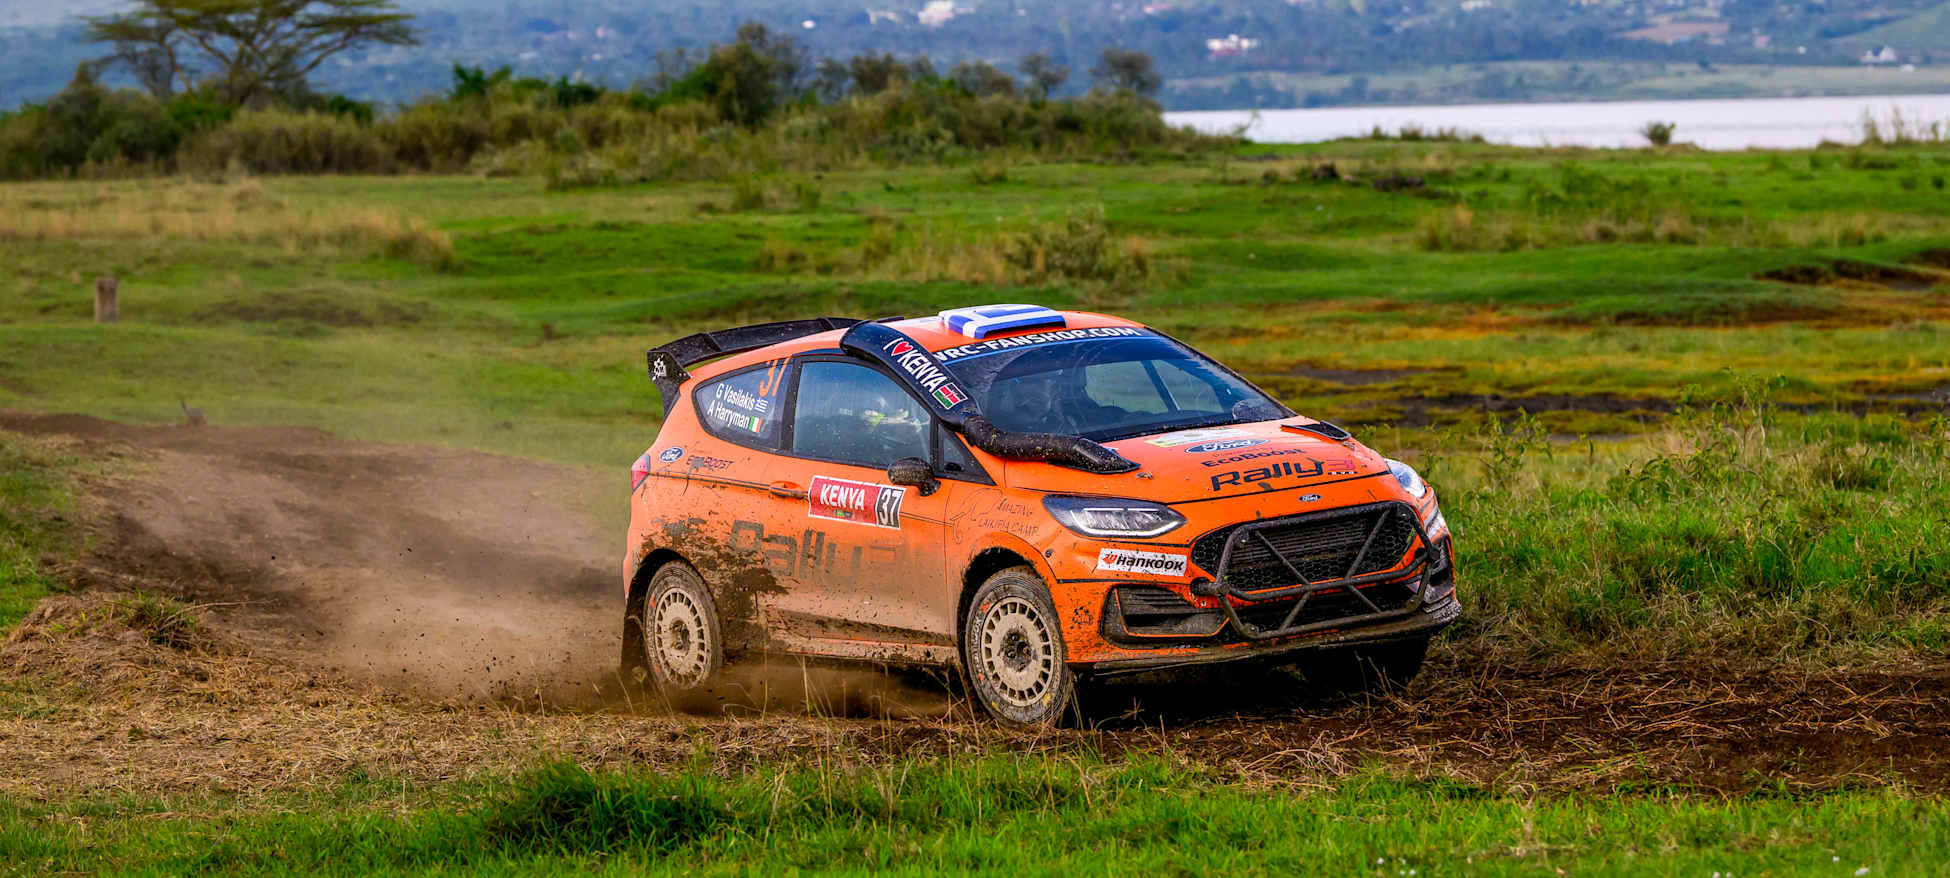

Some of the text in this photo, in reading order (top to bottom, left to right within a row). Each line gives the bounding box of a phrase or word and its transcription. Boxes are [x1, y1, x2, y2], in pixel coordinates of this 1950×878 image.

[883, 338, 949, 393] I KENYA
[716, 383, 756, 411] G Vasilakis
[707, 400, 750, 430] A Harryman
[661, 448, 681, 461] Ford
[1202, 448, 1306, 467] EcoBoost
[1203, 438, 1253, 451] Ford
[820, 483, 902, 526] KENYA 37
